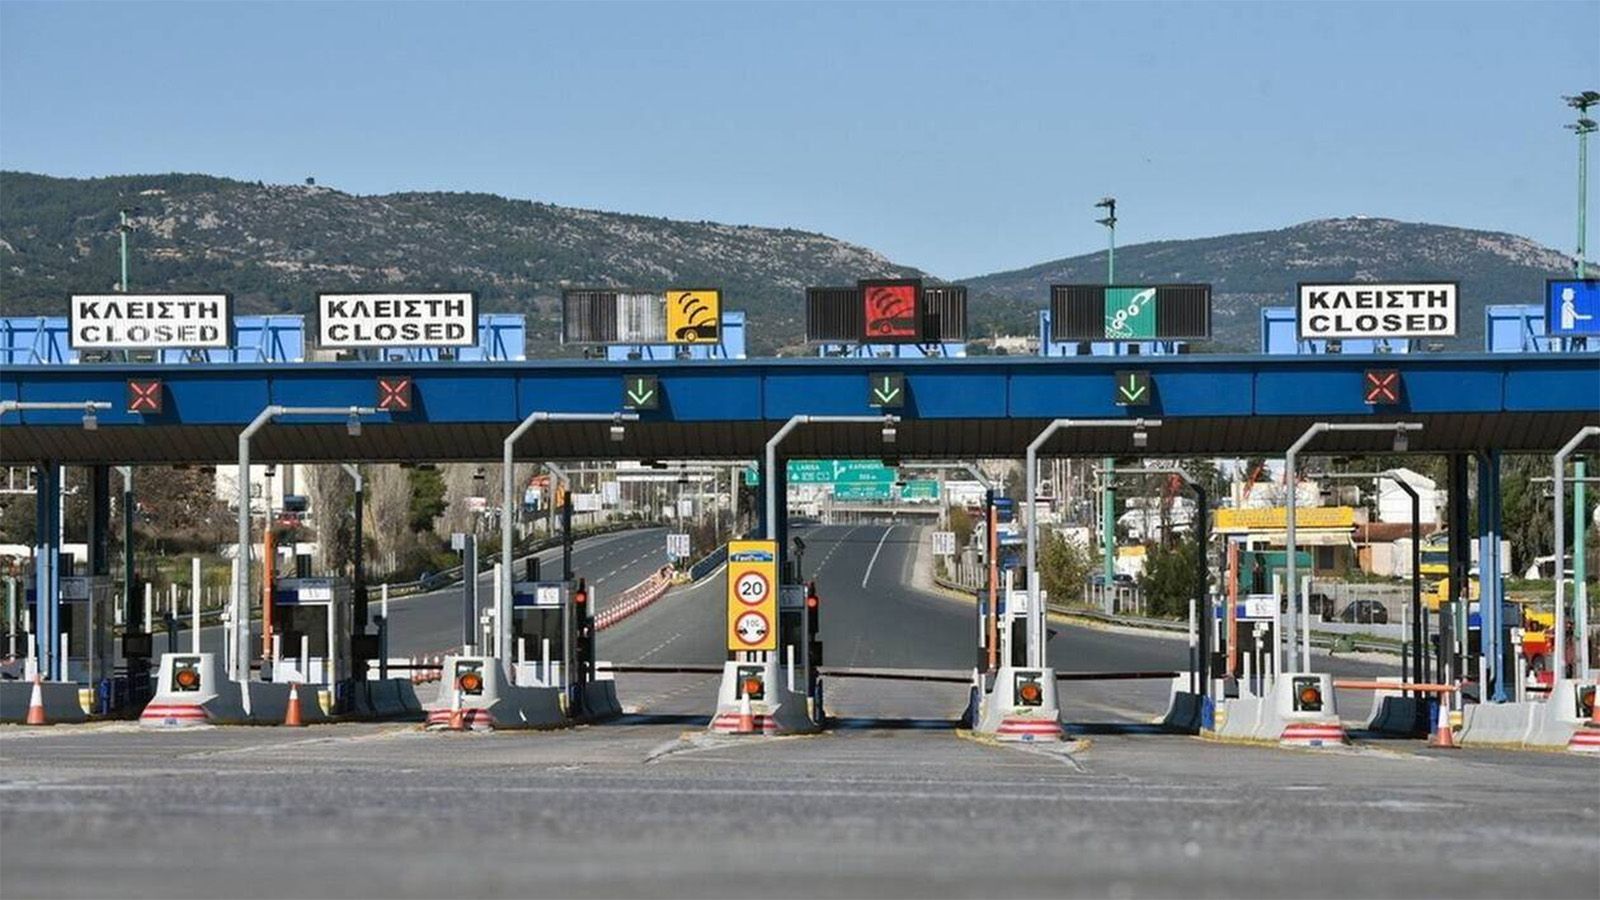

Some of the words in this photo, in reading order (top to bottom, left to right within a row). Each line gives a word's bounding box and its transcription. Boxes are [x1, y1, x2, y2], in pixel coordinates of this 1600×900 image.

[1309, 290, 1447, 309] ΚΛΕΙΣΤΗ
[80, 302, 218, 319] ΚΛΕΙΣΤΗ
[328, 300, 464, 318] ΚΛΕΙΣΤΗ
[328, 323, 465, 341] CLOSED
[1309, 314, 1447, 332] CLOSED
[80, 325, 218, 342] CLOSED
[742, 581, 763, 596] 20
